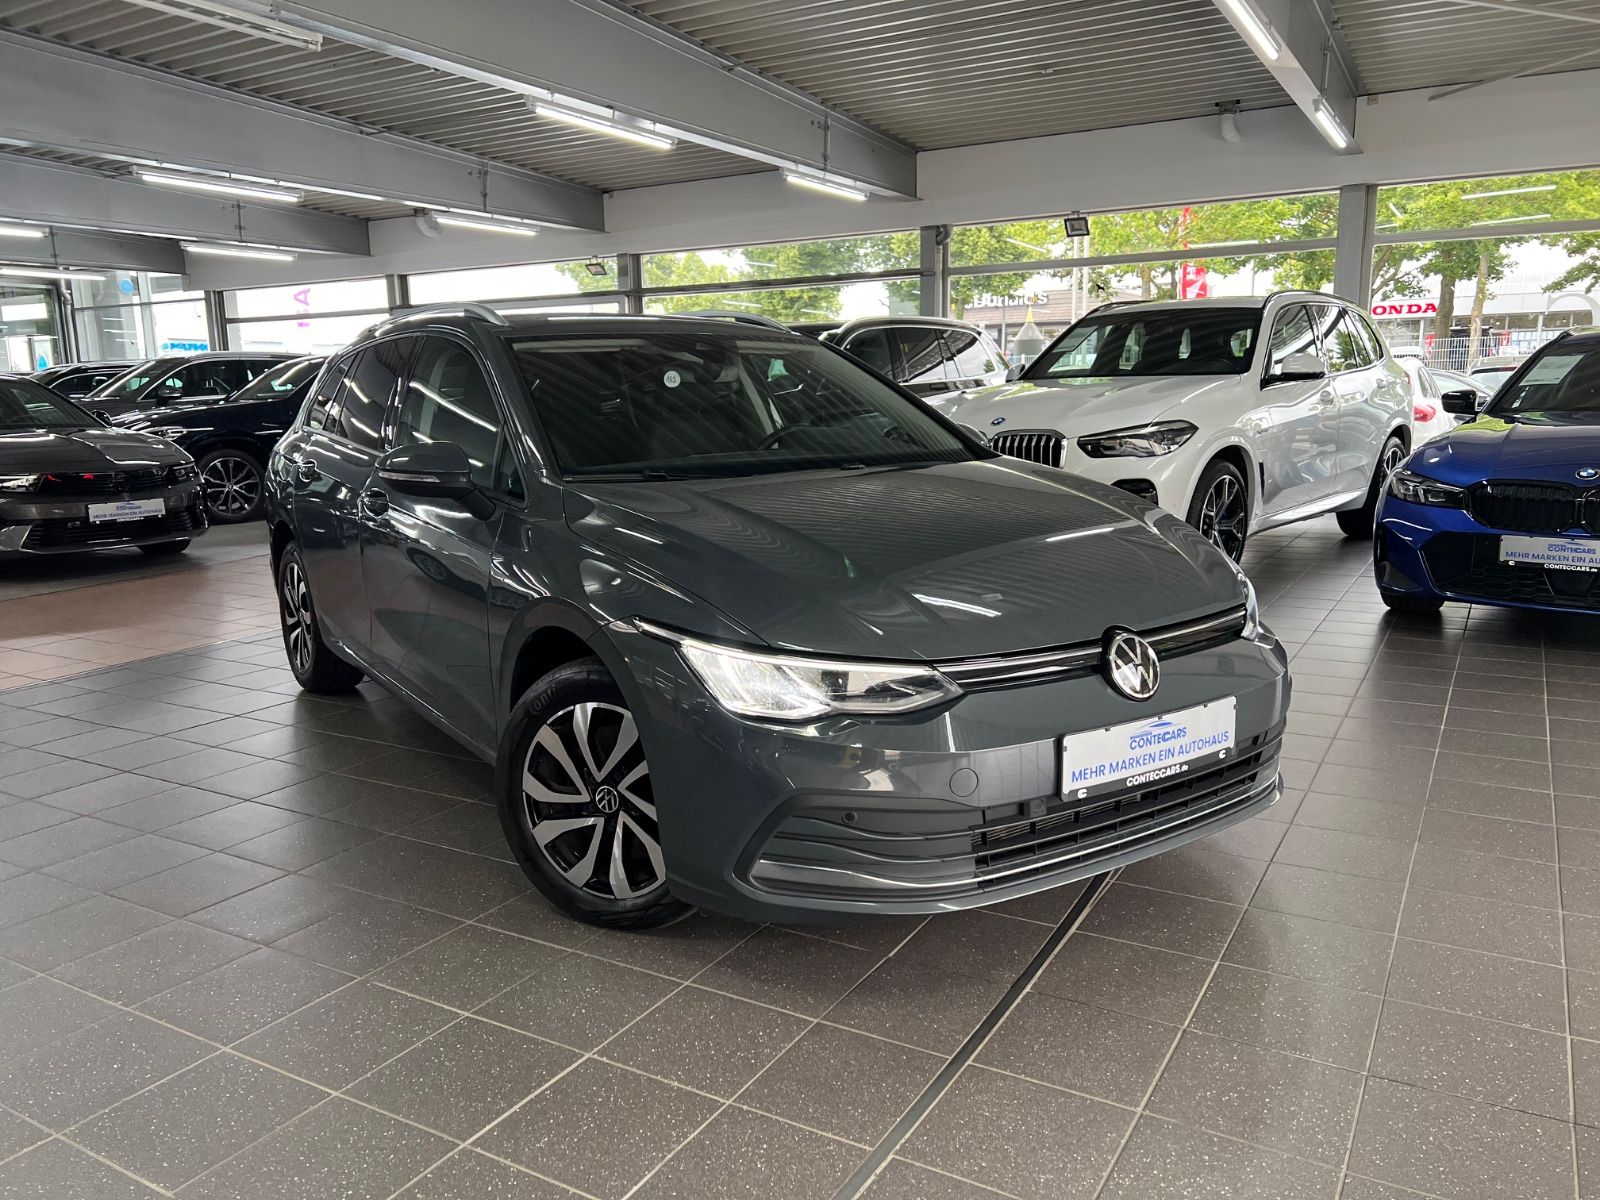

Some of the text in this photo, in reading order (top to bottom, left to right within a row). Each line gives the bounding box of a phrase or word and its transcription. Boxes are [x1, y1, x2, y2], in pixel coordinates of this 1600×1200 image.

[1372, 303, 1438, 316] ONDA
[1505, 551, 1530, 559] MEHR
[1531, 553, 1569, 562] MARKEN
[1571, 555, 1586, 564] EIN
[1071, 764, 1106, 784] MEHR
[1109, 752, 1156, 775] MARKEN
[1158, 746, 1175, 762] EIN
[1178, 730, 1229, 756] AUTOHAUS
